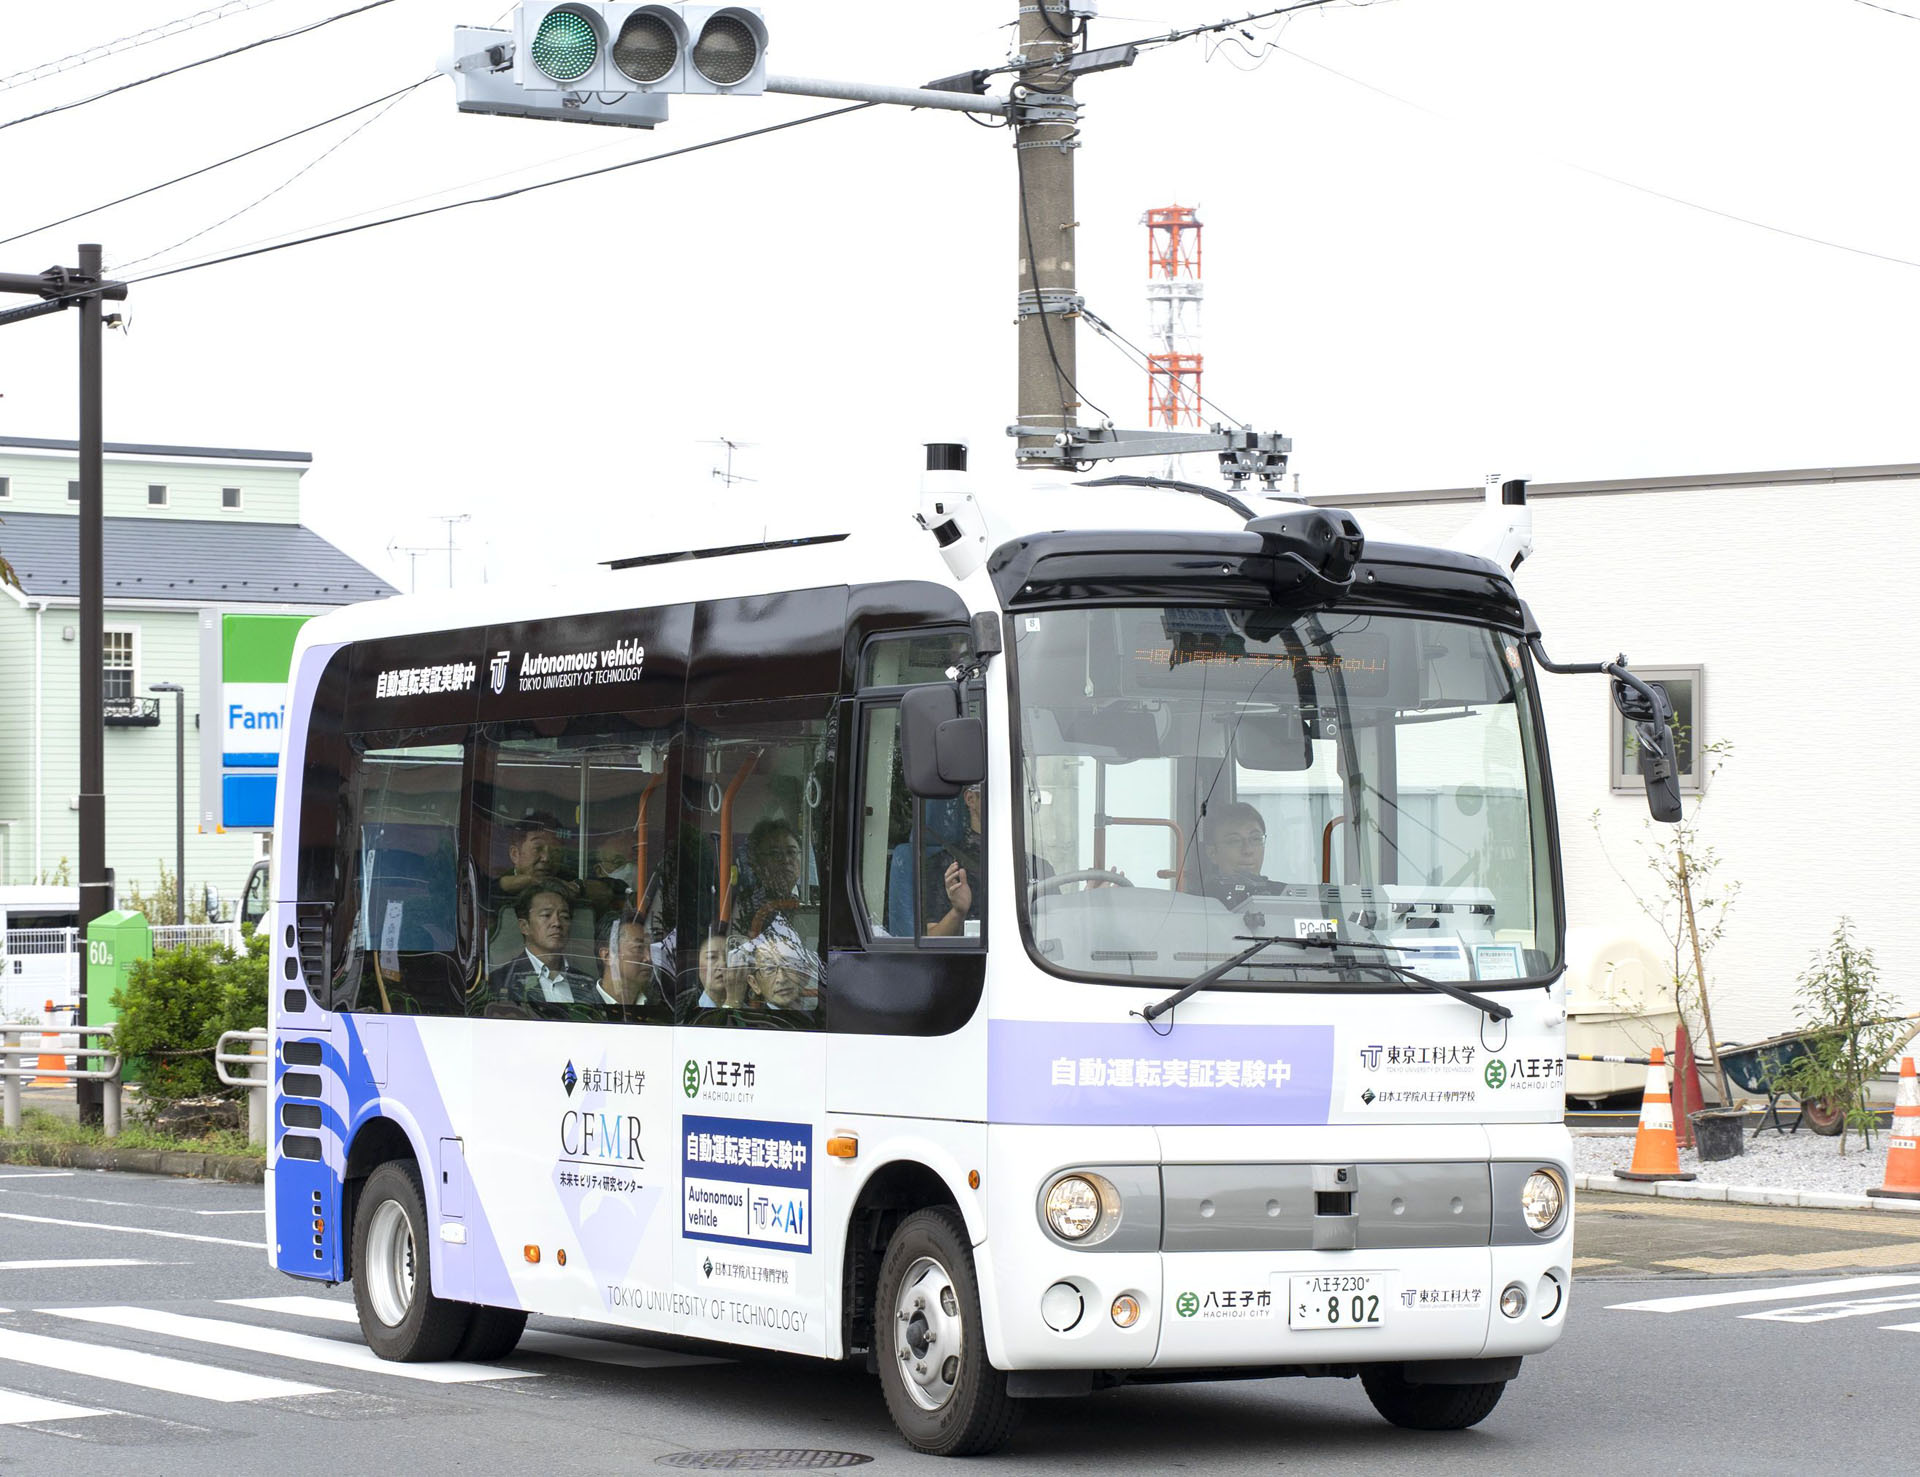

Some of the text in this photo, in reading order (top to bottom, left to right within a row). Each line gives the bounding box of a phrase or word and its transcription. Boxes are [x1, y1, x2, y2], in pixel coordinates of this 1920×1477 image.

[519, 637, 645, 677] Autonomous vehicle
[376, 661, 477, 699] 自動運転実証実験中
[519, 666, 643, 692] TOKYO UNIVERSITY OF TECHNOLOGY
[229, 704, 285, 730] Fami
[1299, 922, 1334, 933] PC-05
[1386, 1045, 1476, 1066] 東京工科大学
[703, 1060, 756, 1089] 八王子市
[1051, 1056, 1292, 1089] 自動運転実証実験中
[1510, 1057, 1564, 1079] 八王子市
[582, 1067, 646, 1095] 東京工科大学
[1510, 1081, 1548, 1090] HACHIOJI
[702, 1090, 755, 1103] HACHIOJI CITY
[1378, 1090, 1476, 1103] 日本工学院八王子専門学校
[561, 1110, 646, 1162] CFMR
[687, 1131, 807, 1172] 自動運転実証実験中
[559, 1170, 644, 1194] 未来モビリティ研究センター
[688, 1185, 744, 1208] Autonomous
[688, 1207, 718, 1228] vehicle
[715, 1261, 790, 1285] 日本工学院八王子専門学校
[1312, 1276, 1366, 1293] 八王子230
[1203, 1290, 1272, 1308] 八王子市
[1419, 1288, 1482, 1303] 東京工科大学
[607, 1285, 809, 1333] TOKYO UNIVERSITY OF TECHNOLOGY
[1203, 1309, 1271, 1318] HACHIOJI CITY
